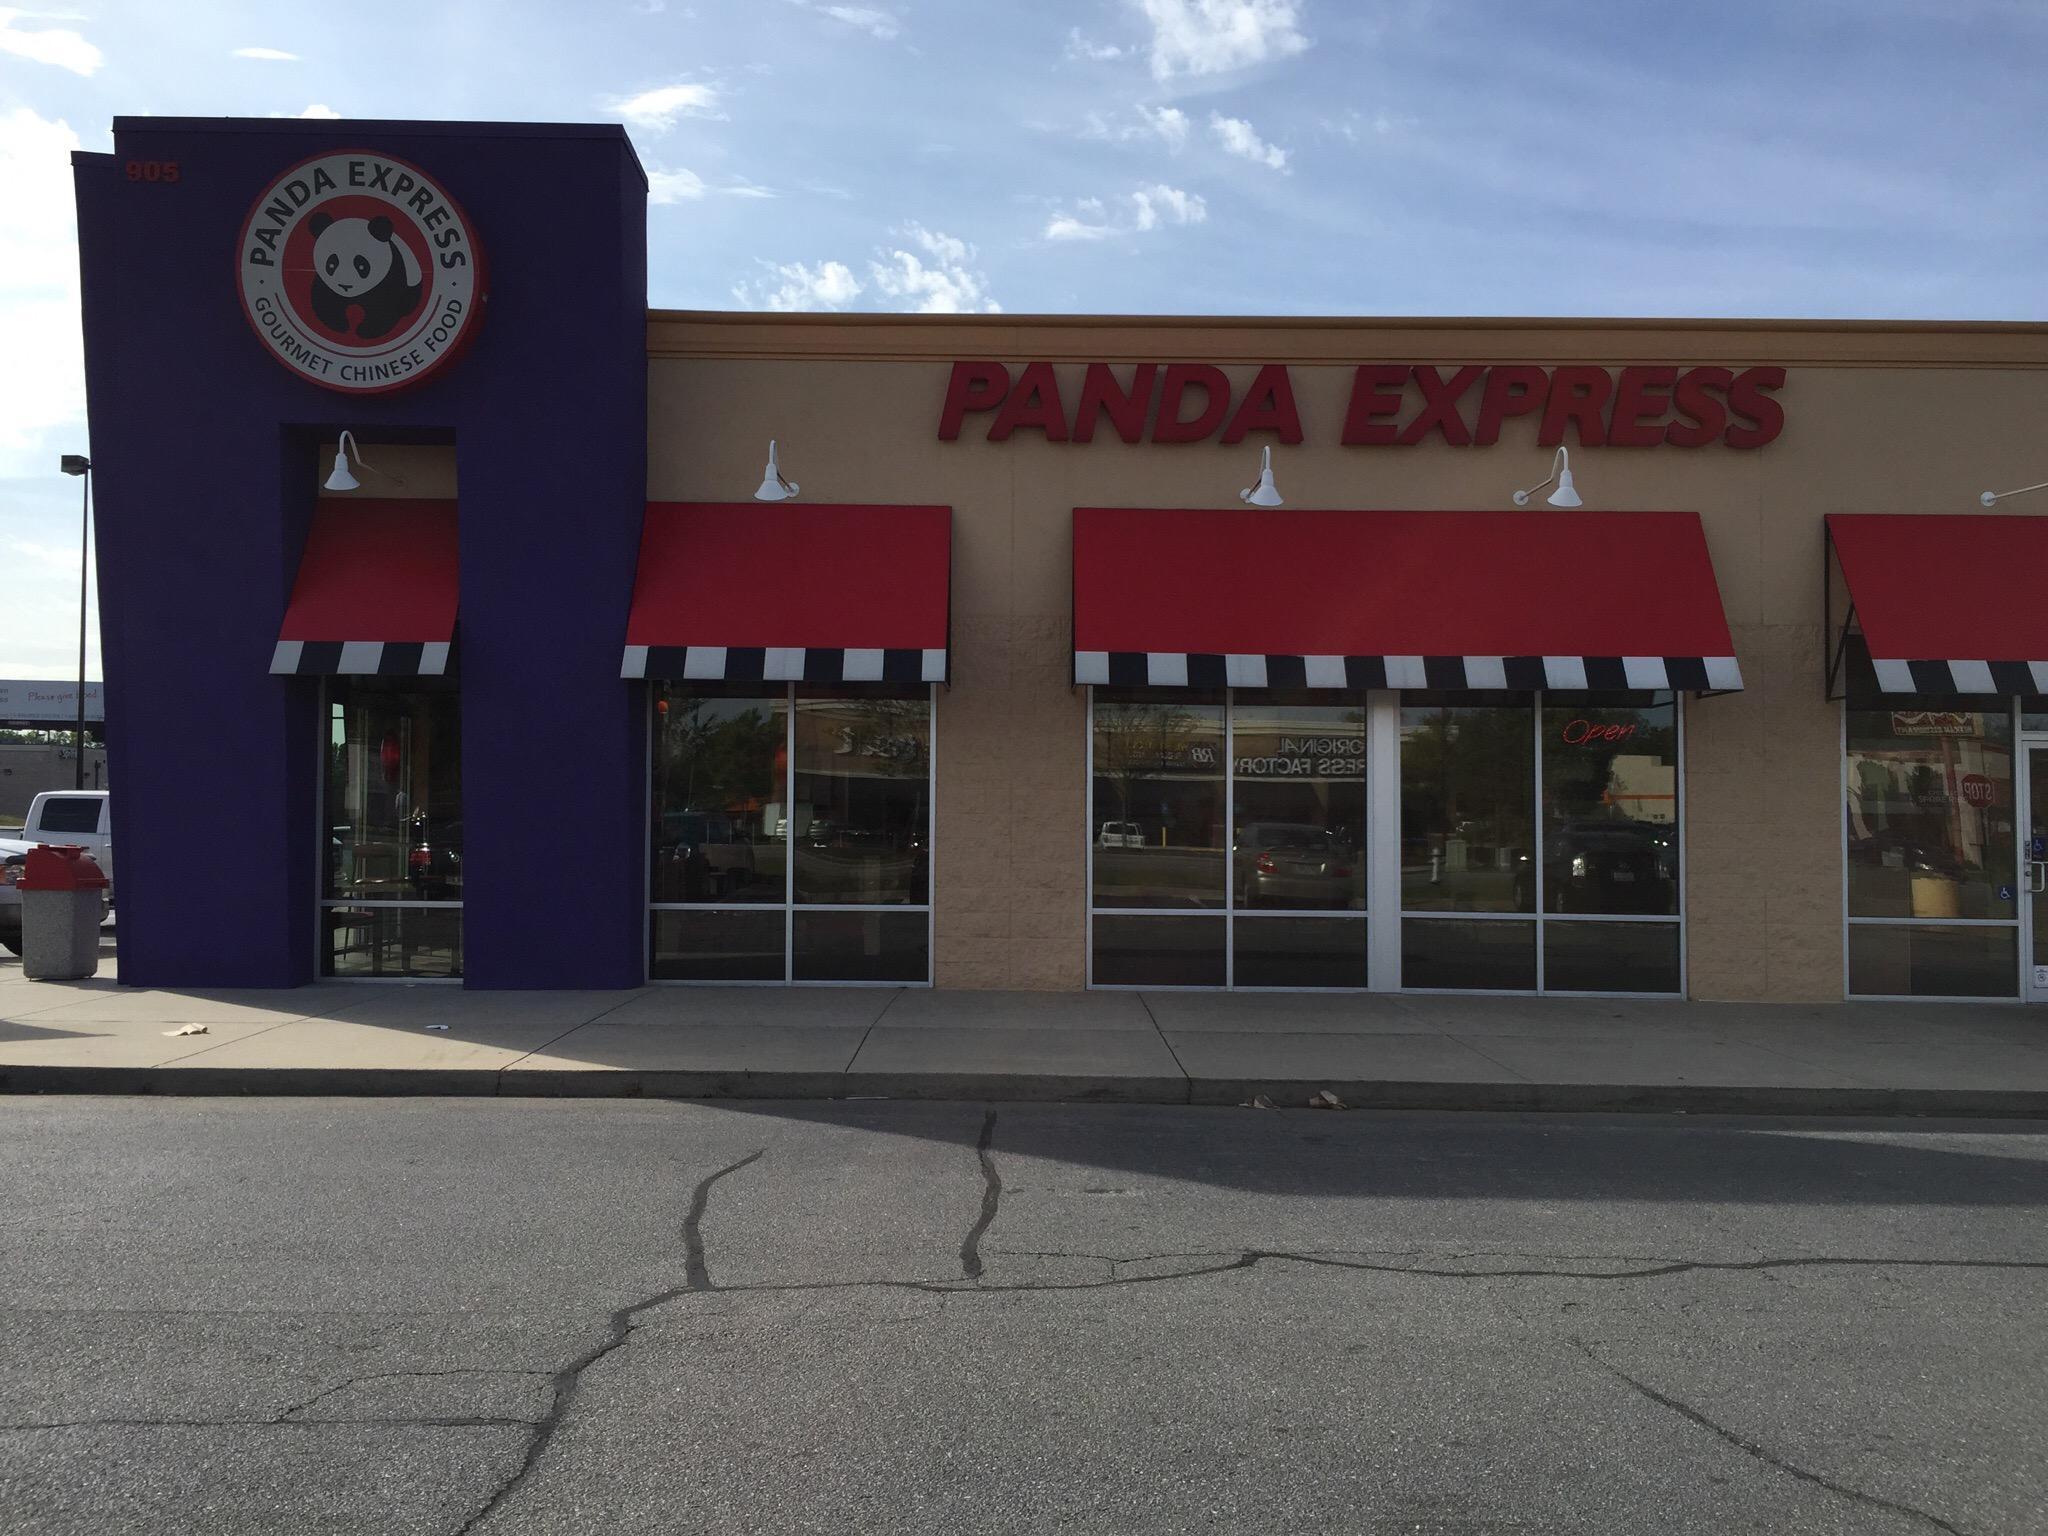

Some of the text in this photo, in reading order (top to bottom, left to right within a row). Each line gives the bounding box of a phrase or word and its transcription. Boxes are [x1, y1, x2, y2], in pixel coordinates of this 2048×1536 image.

[126, 160, 178, 181] 905
[250, 161, 466, 269] PANDA EXPRESS
[255, 297, 462, 381] GOURMET CHINESE FOOD
[938, 361, 1787, 449] PANDA EXPRESS
[27, 691, 55, 701] Please
[57, 692, 74, 703] give
[1562, 719, 1637, 745] Open
